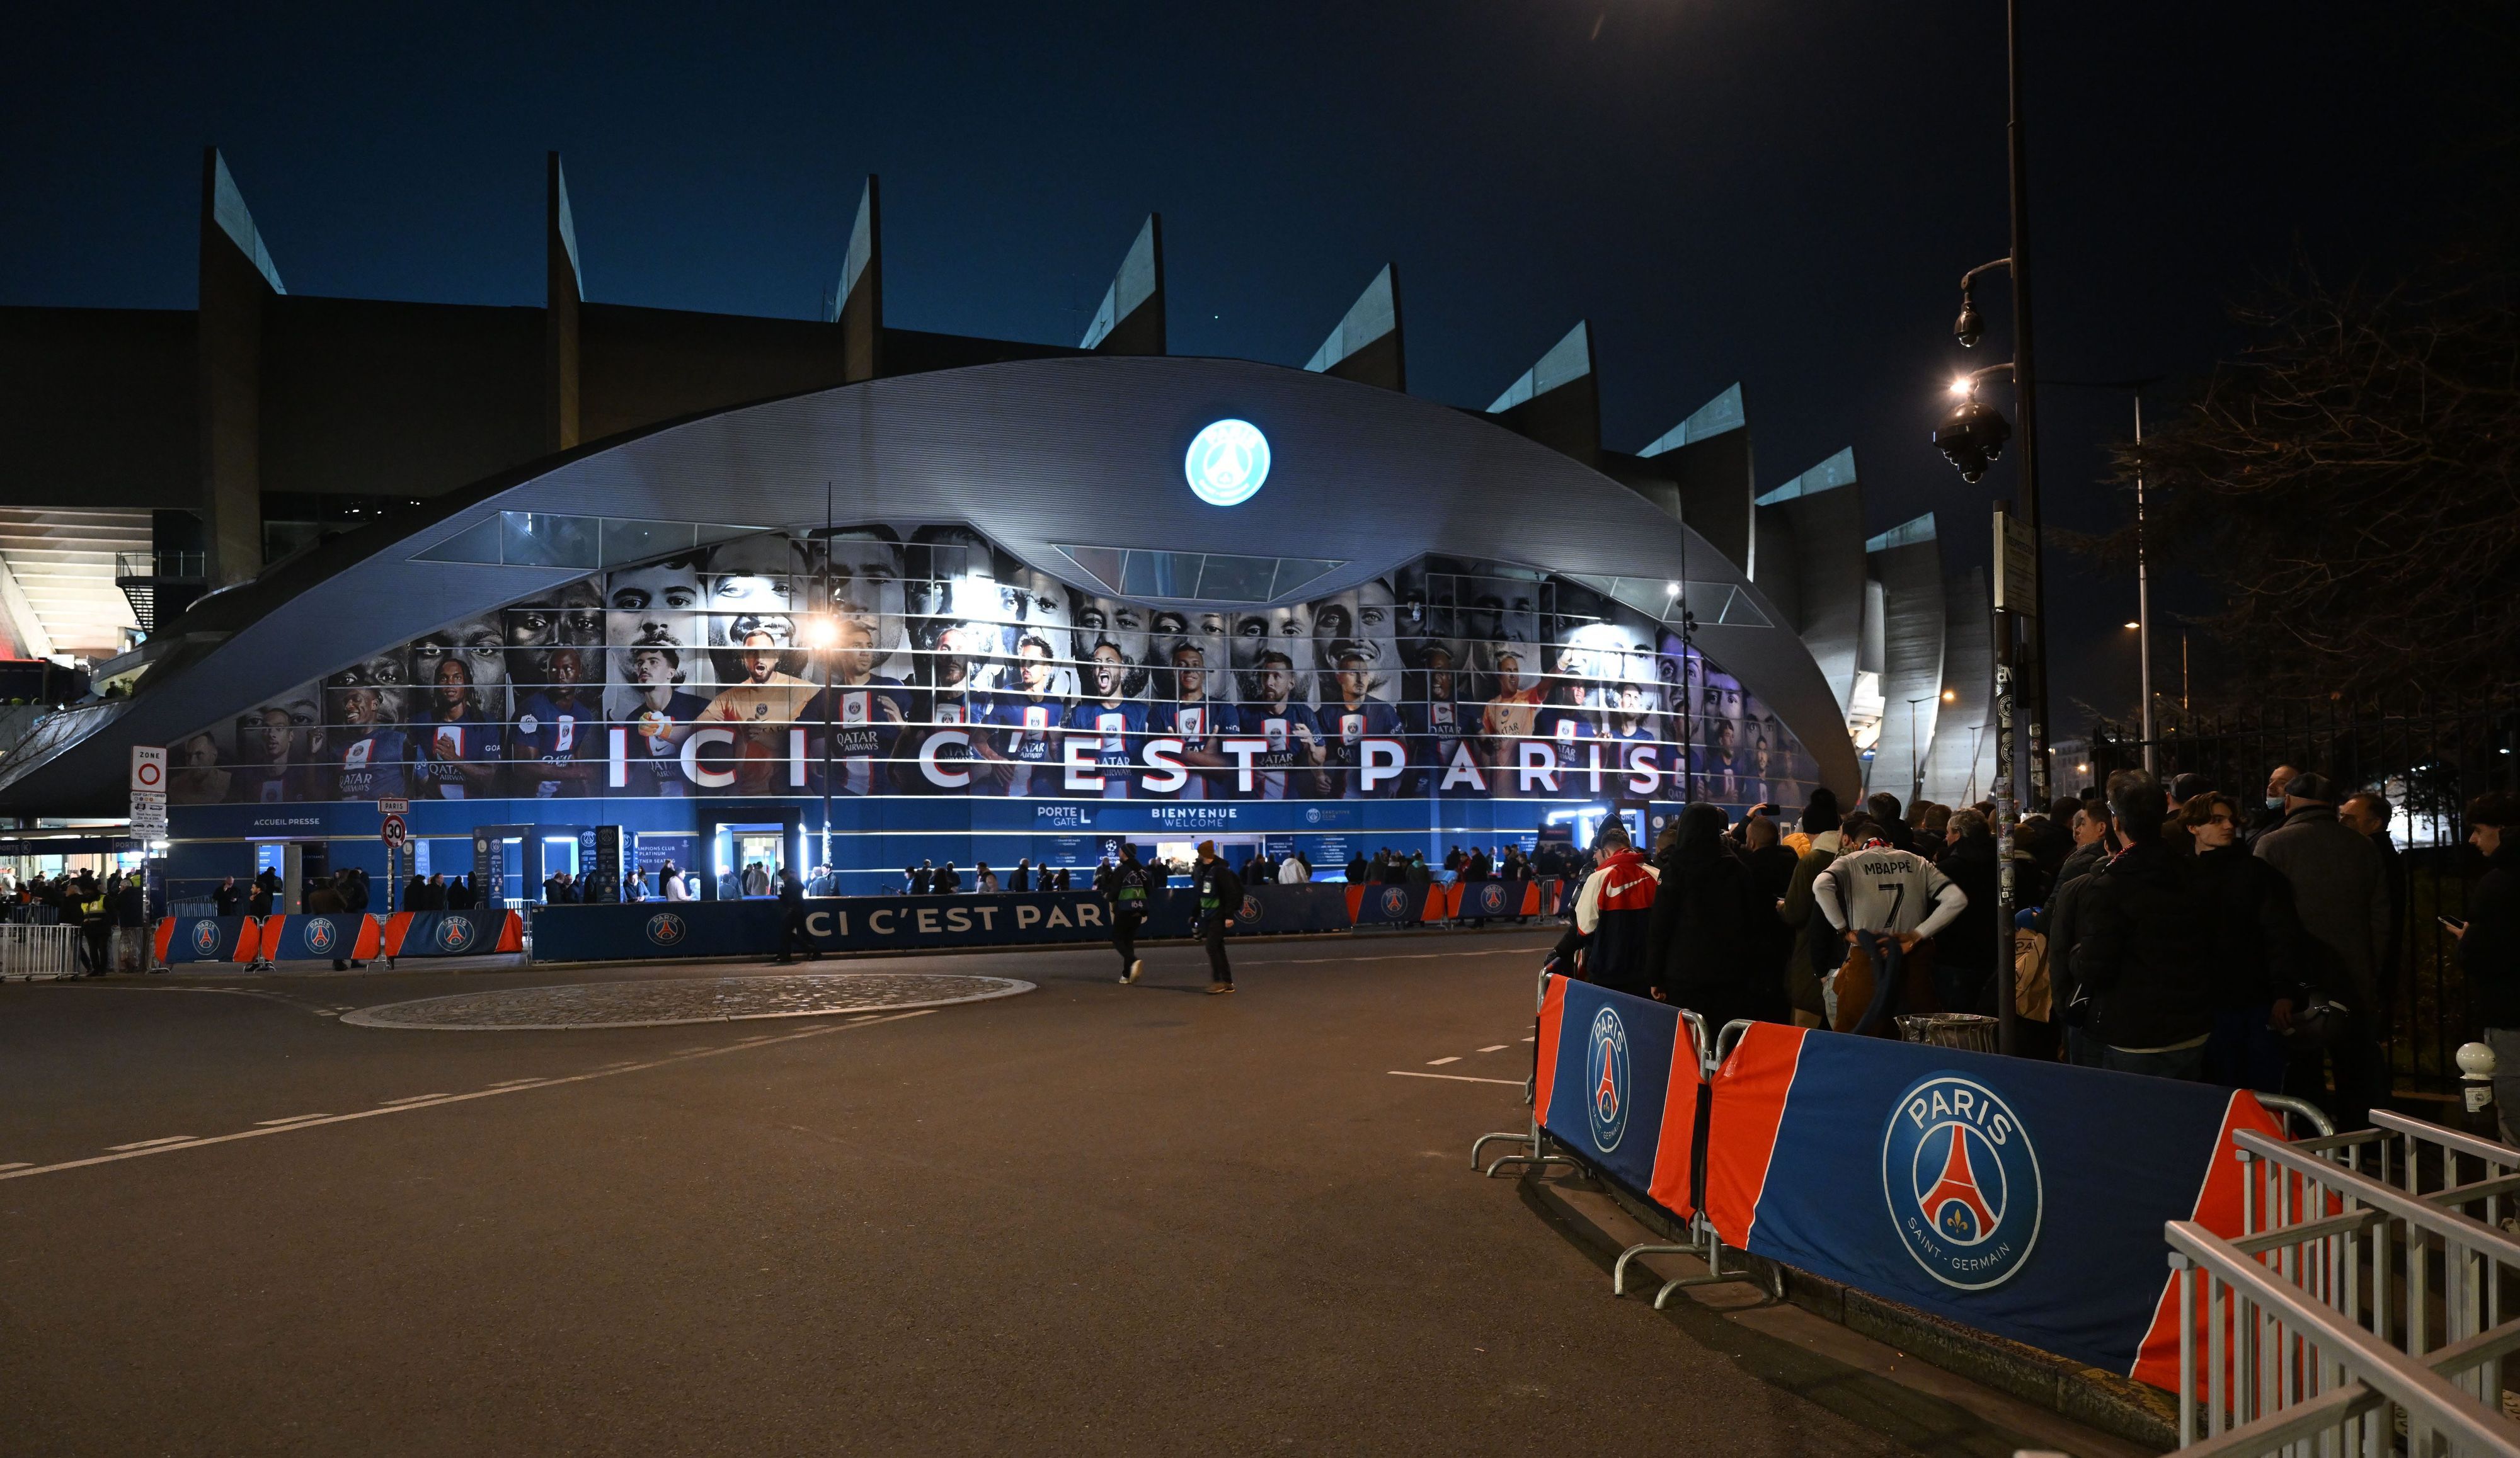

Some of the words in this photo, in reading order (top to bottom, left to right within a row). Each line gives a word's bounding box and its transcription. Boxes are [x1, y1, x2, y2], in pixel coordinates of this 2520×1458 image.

[837, 731, 878, 746] QATAR
[844, 743, 879, 751] AIRWAYS
[609, 727, 808, 787] ICI
[919, 729, 1269, 792] C'EST
[1361, 738, 1661, 795] PARIS
[1038, 807, 1077, 817] PORTE
[1080, 809, 1091, 823] L
[1152, 809, 1237, 818] BIENVENUE
[1053, 817, 1077, 826] GATE
[1165, 819, 1223, 827] WELCOME
[387, 824, 402, 839] 30
[1878, 884, 1904, 928] 7
[309, 919, 331, 928] PARIS
[442, 918, 467, 927] PARIS
[653, 914, 679, 923] PARIS
[869, 906, 999, 935] C'EST
[197, 921, 215, 931] PARIS
[1595, 1014, 1623, 1053] PARIS
[1908, 1088, 2012, 1146] PARIS
